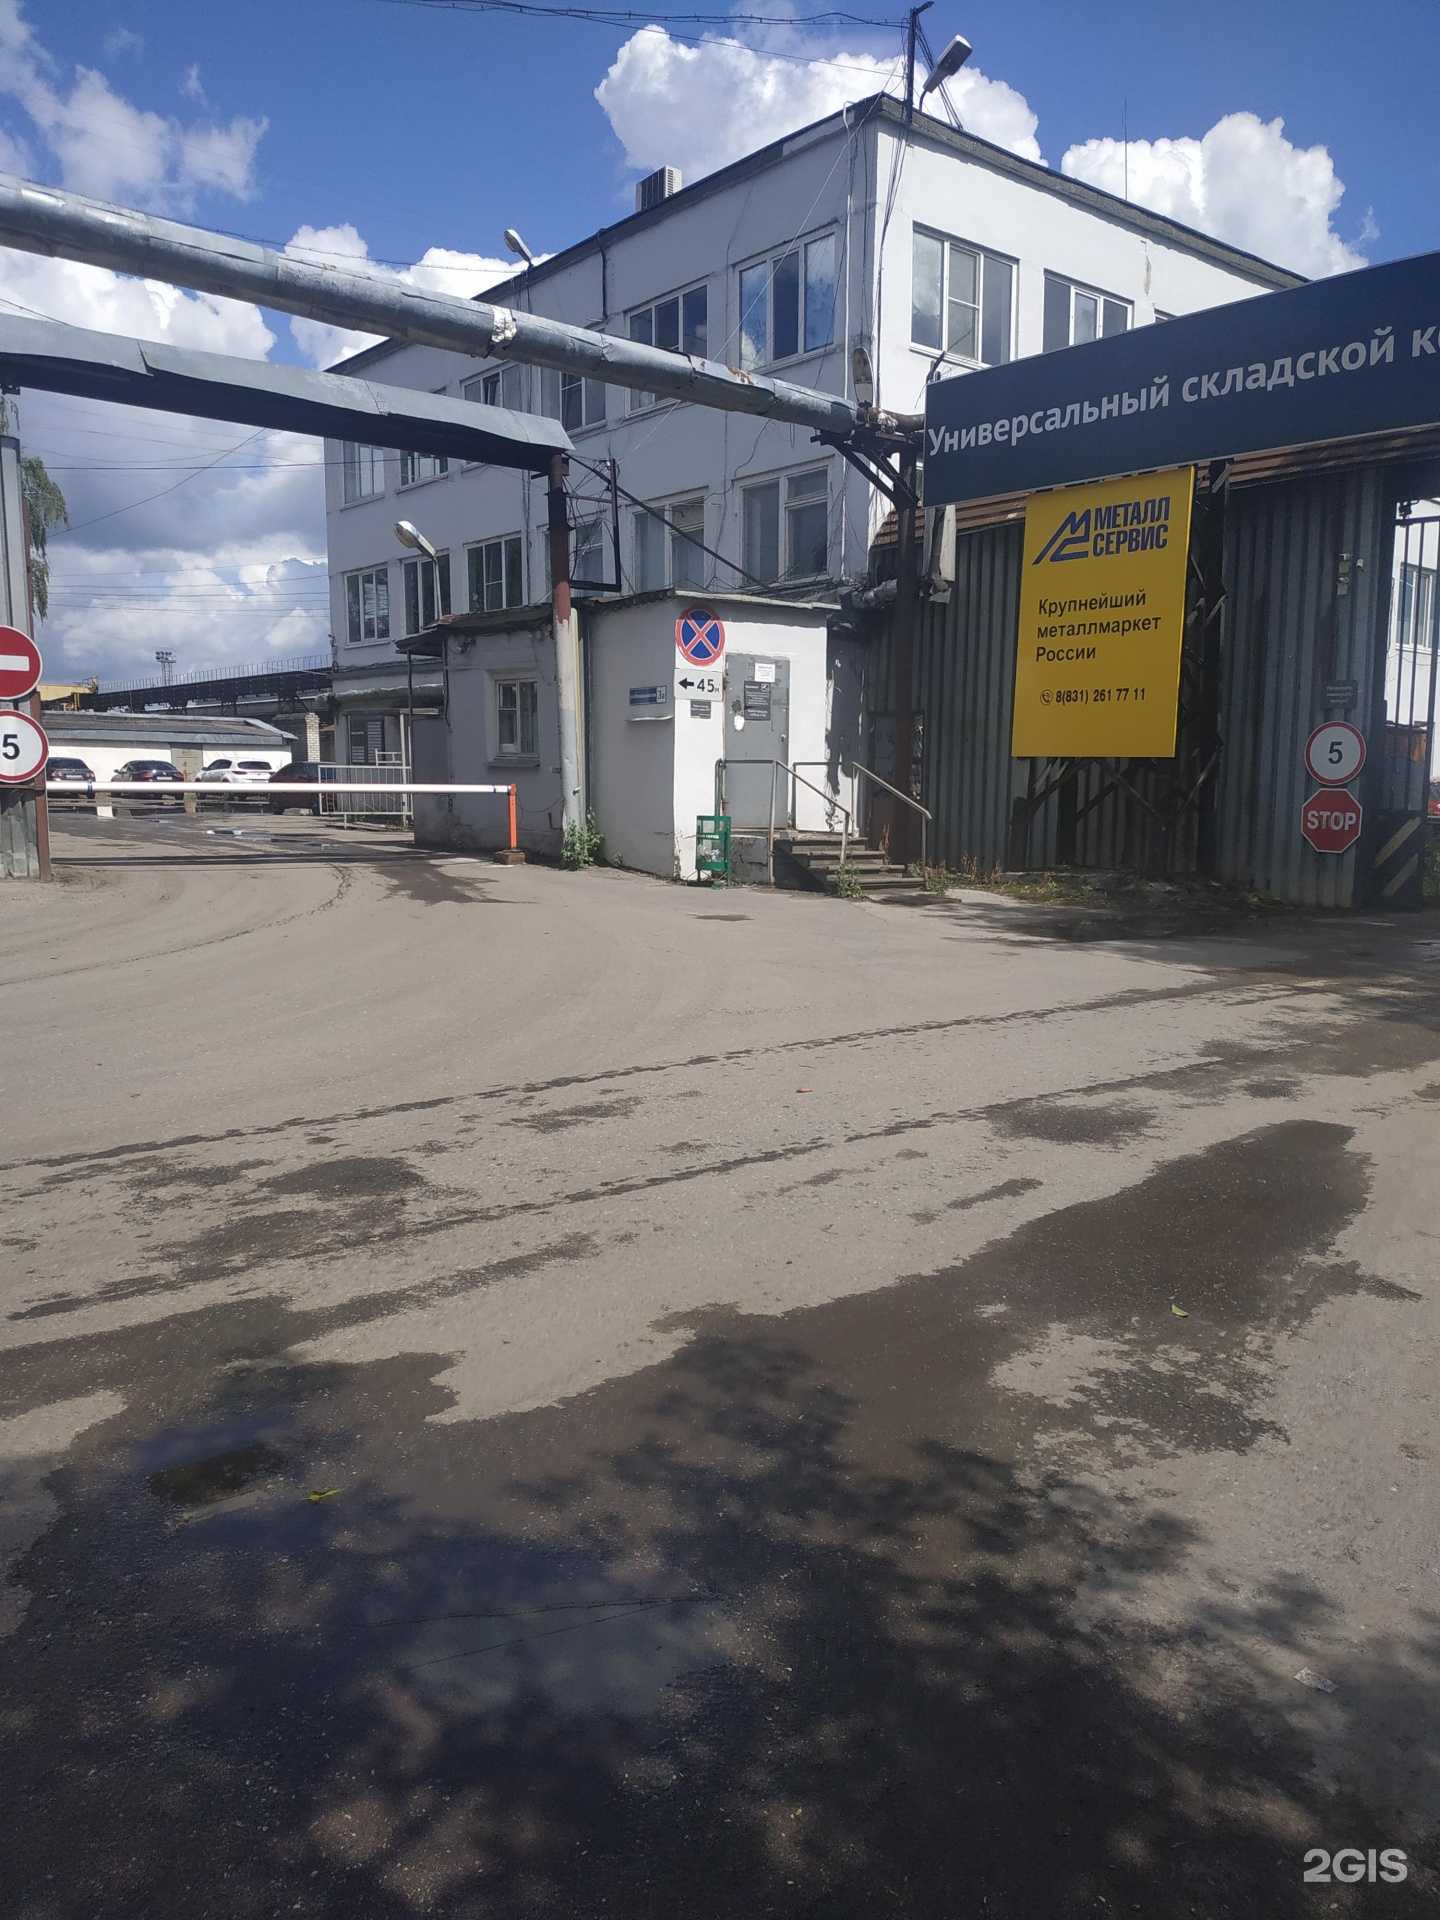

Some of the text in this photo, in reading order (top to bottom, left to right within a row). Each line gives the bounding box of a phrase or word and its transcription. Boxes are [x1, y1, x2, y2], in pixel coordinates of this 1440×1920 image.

[928, 326, 1440, 456] Универсальный складской к
[1094, 496, 1171, 531] МЕТАЛЛ
[1093, 524, 1168, 557] СЕРВИС
[1038, 588, 1146, 617] Крупнейший
[1037, 616, 1161, 638] металлмаркет
[1036, 646, 1096, 662] России
[1055, 688, 1145, 705] 8(831) 261 77 11
[2, 733, 20, 760] 5
[1328, 741, 1343, 764] 5
[1307, 811, 1356, 831] STOP
